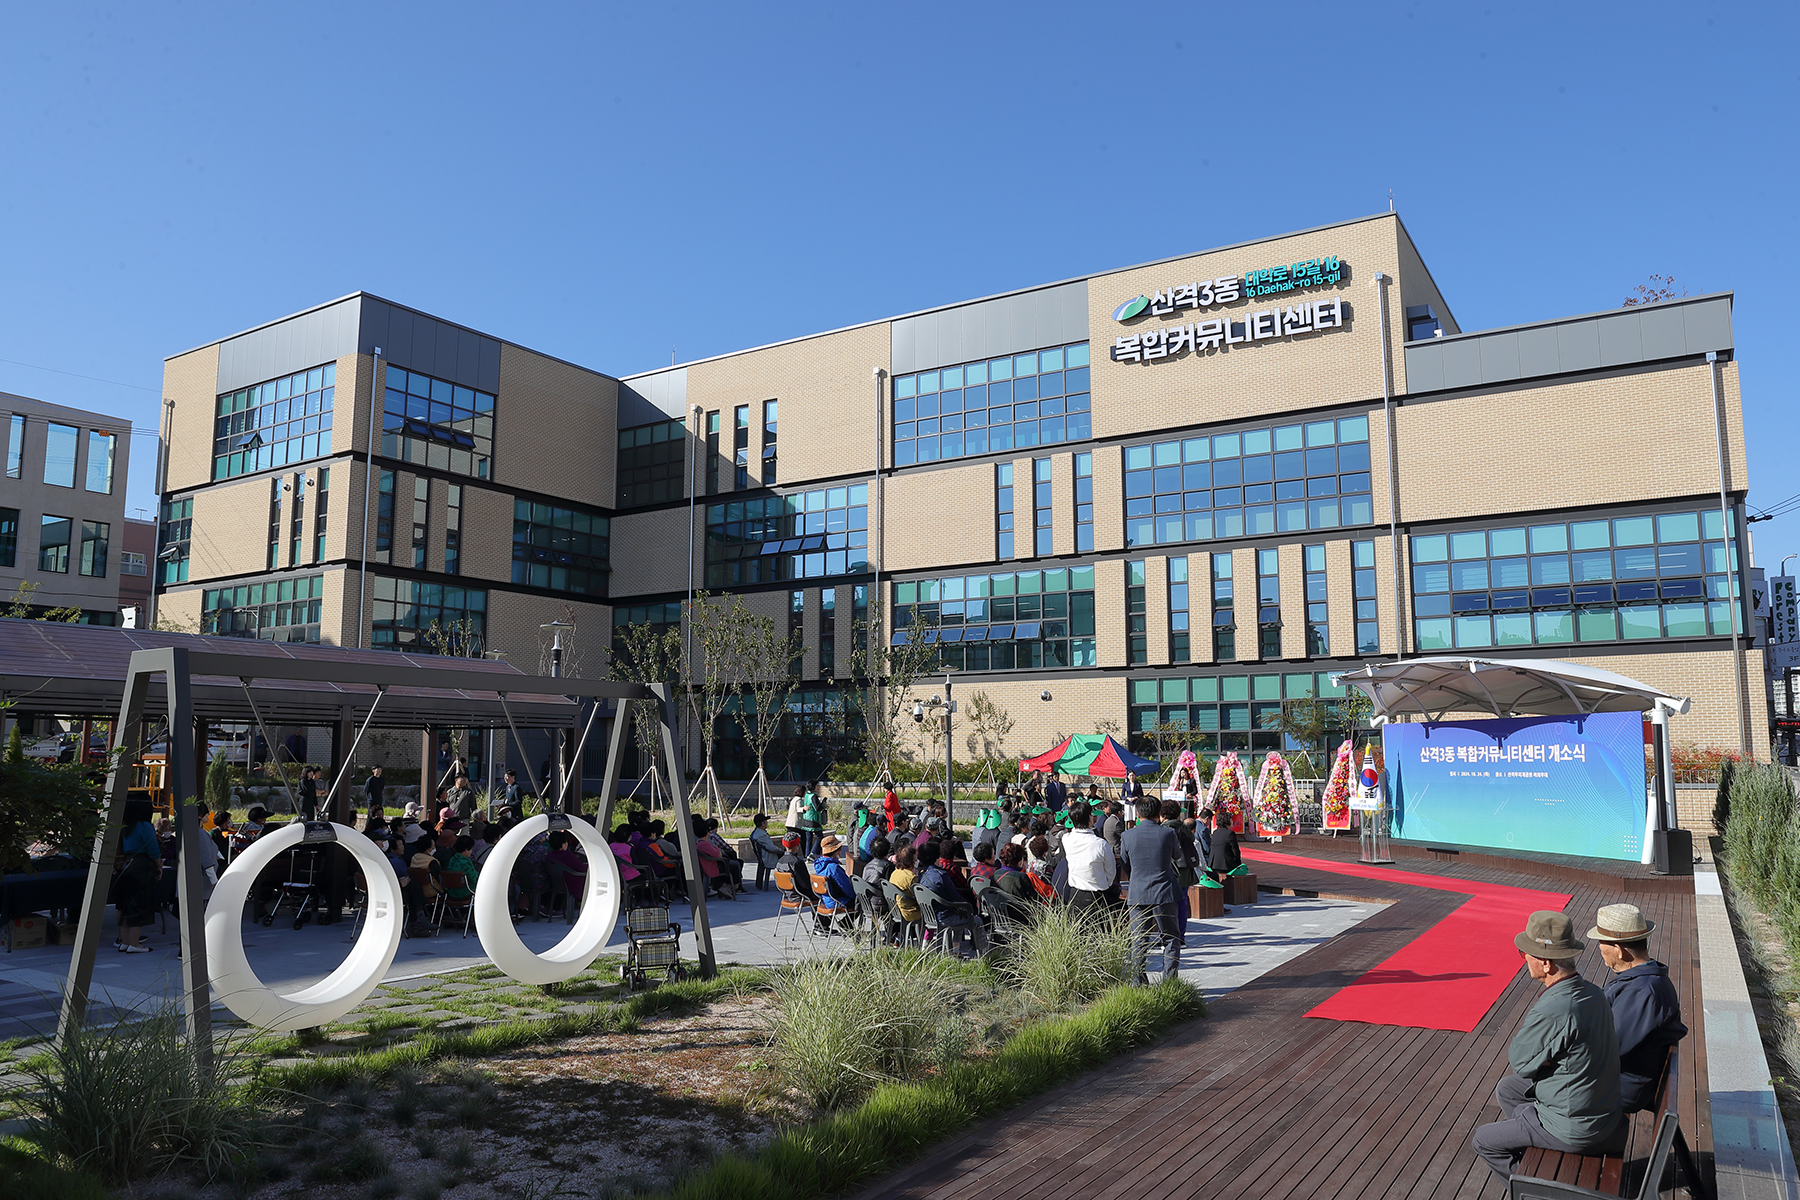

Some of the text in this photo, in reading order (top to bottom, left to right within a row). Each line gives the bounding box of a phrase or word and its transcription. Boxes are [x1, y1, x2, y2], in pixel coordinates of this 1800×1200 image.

[1245, 255, 1340, 287] 대학로 15길 16
[1245, 270, 1341, 298] 16 Daehak-ro 15-gil
[1150, 274, 1239, 316] 산격3동
[1115, 296, 1343, 362] 복합커뮤니티센터
[1775, 581, 1796, 644] Forest Company
[1420, 743, 1586, 763] 산격3동 복합커뮤니티센터 개소식
